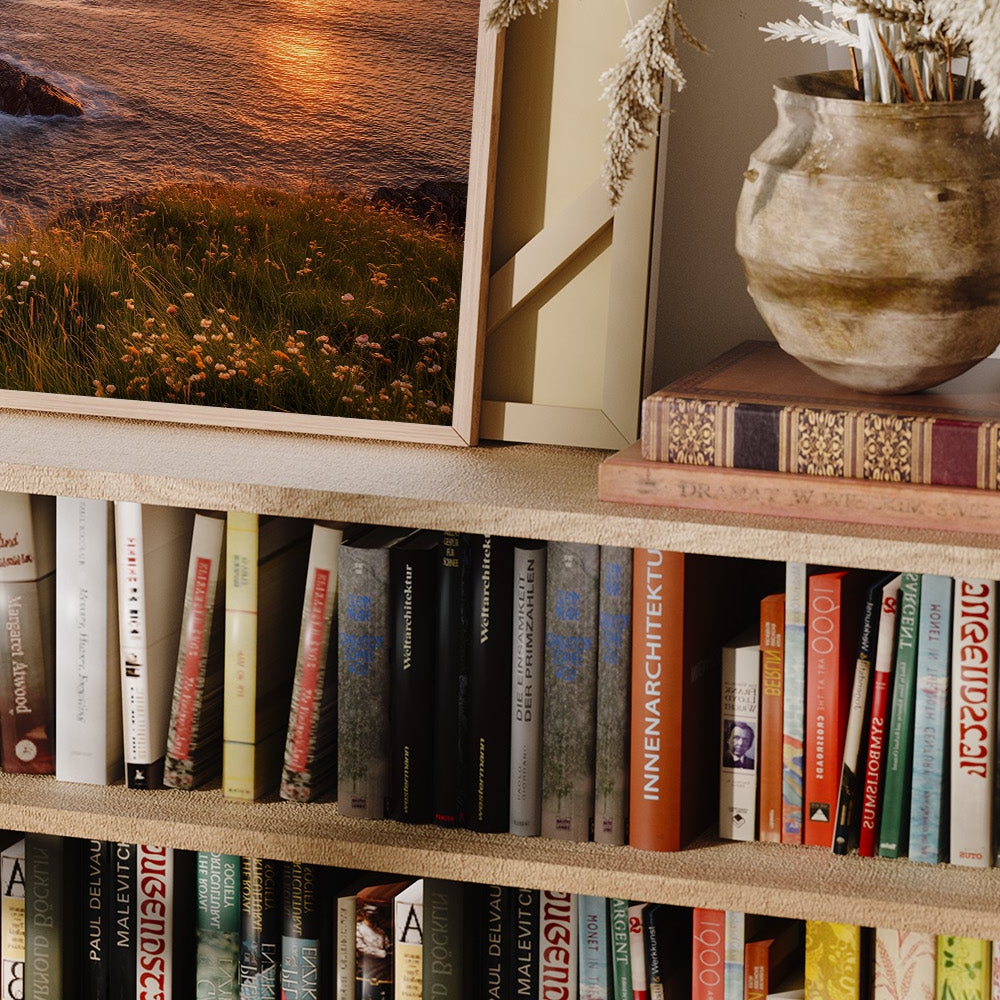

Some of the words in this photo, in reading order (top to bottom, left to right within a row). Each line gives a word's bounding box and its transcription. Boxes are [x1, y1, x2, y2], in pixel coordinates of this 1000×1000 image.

[5, 596, 27, 657] Margaret
[403, 563, 413, 671] Weltarchitektur
[516, 574, 527, 687] EINSAMKEIT
[524, 558, 536, 680] PRIMZAHLEN
[12, 661, 33, 714] Atwood
[515, 690, 525, 723] DIE
[523, 685, 534, 723] DER
[643, 549, 664, 802] INNENARCHITEKTU
[402, 745, 411, 814] westermann
[477, 737, 486, 821] westermann
[89, 841, 102, 911] DELVAU
[89, 916, 102, 962] PAUL
[488, 886, 501, 957] DELVAU
[587, 914, 598, 952] MONET
[612, 899, 631, 966] ARGENT
[648, 926, 660, 976] Werkkunst
[693, 921, 721, 986] 1900
[588, 958, 598, 969] IN
